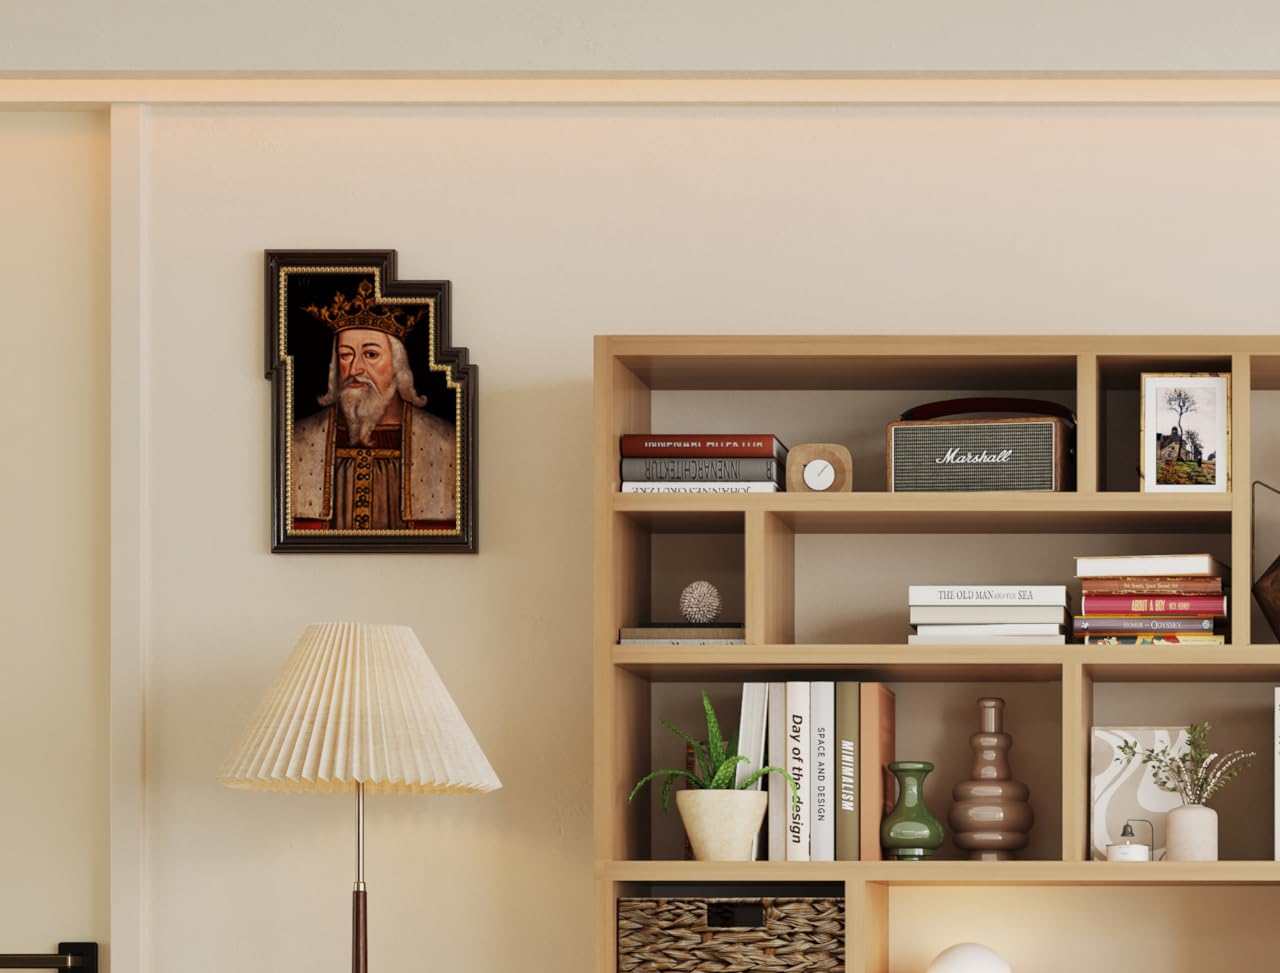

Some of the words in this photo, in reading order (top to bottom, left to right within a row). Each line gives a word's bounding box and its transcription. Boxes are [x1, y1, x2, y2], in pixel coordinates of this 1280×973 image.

[935, 447, 1013, 464] Marshall
[645, 460, 740, 480] INNENARCHITEKTUR
[938, 590, 954, 600] THE
[956, 590, 974, 600] OLD
[975, 590, 994, 600] MAN
[1017, 590, 1033, 600] SEA
[1150, 620, 1182, 630] ODYSSEY
[789, 714, 803, 743] Day
[791, 746, 803, 764] of
[791, 766, 803, 790] the
[841, 740, 854, 811] MINIMALISM
